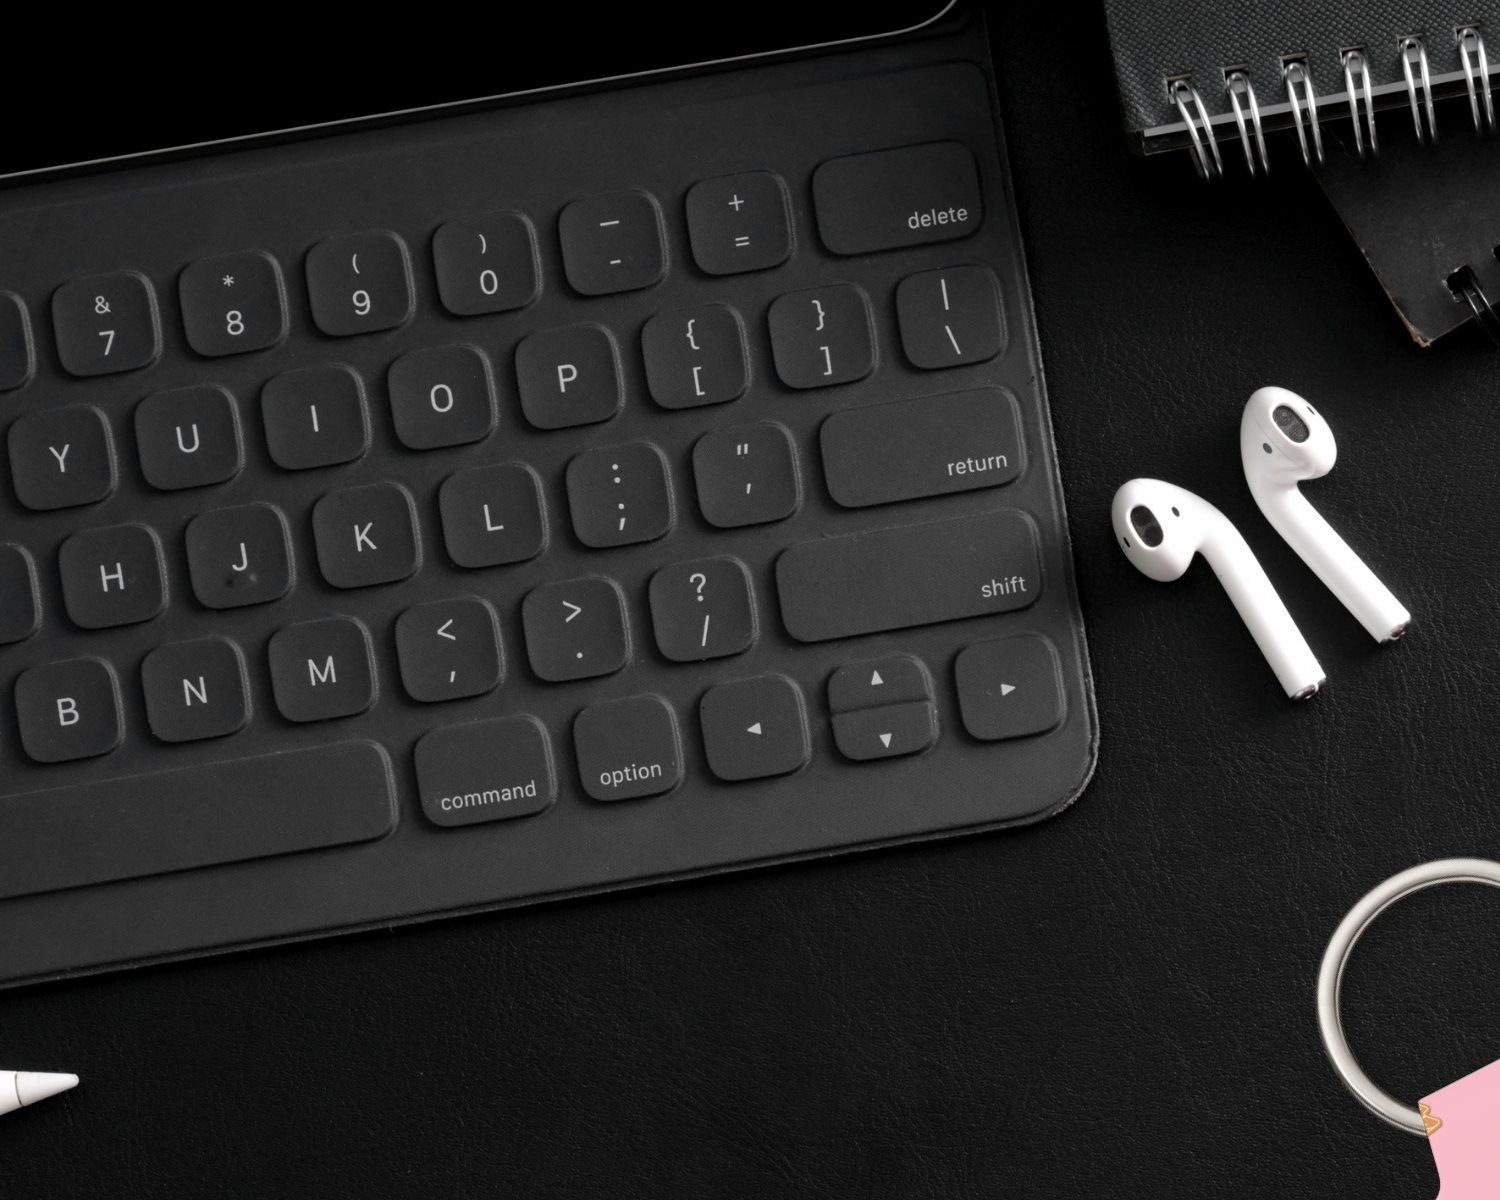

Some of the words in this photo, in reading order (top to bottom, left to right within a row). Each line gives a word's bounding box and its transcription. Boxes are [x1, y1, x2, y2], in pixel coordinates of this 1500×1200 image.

[728, 194, 745, 212] +
[907, 207, 968, 230] delete
[478, 233, 487, 254] )
[734, 236, 750, 247] =
[352, 253, 360, 274] (
[479, 269, 499, 295] 0
[94, 295, 111, 315] &
[352, 289, 371, 316] 9
[811, 299, 826, 331] }
[226, 310, 245, 336] 8
[686, 318, 700, 350] {
[98, 329, 115, 356] 7
[944, 325, 962, 355] \
[819, 345, 833, 376] ]
[557, 363, 578, 393] P
[692, 366, 706, 397] [
[430, 383, 454, 413] O
[310, 404, 319, 433] I
[175, 423, 200, 454] U
[48, 443, 70, 473] Y
[947, 454, 1008, 476] return
[611, 463, 621, 484] :
[483, 503, 505, 532] L
[618, 503, 626, 531] ;
[353, 522, 378, 553] K
[231, 542, 248, 572] J
[99, 562, 125, 593] H
[689, 572, 707, 602] ?
[981, 575, 1027, 598] shift
[562, 600, 582, 623] >
[436, 618, 456, 641] <
[701, 614, 710, 647] /
[307, 655, 337, 687] M
[182, 676, 208, 707] N
[56, 697, 80, 727] B
[600, 763, 662, 788] option
[440, 779, 537, 811] command
